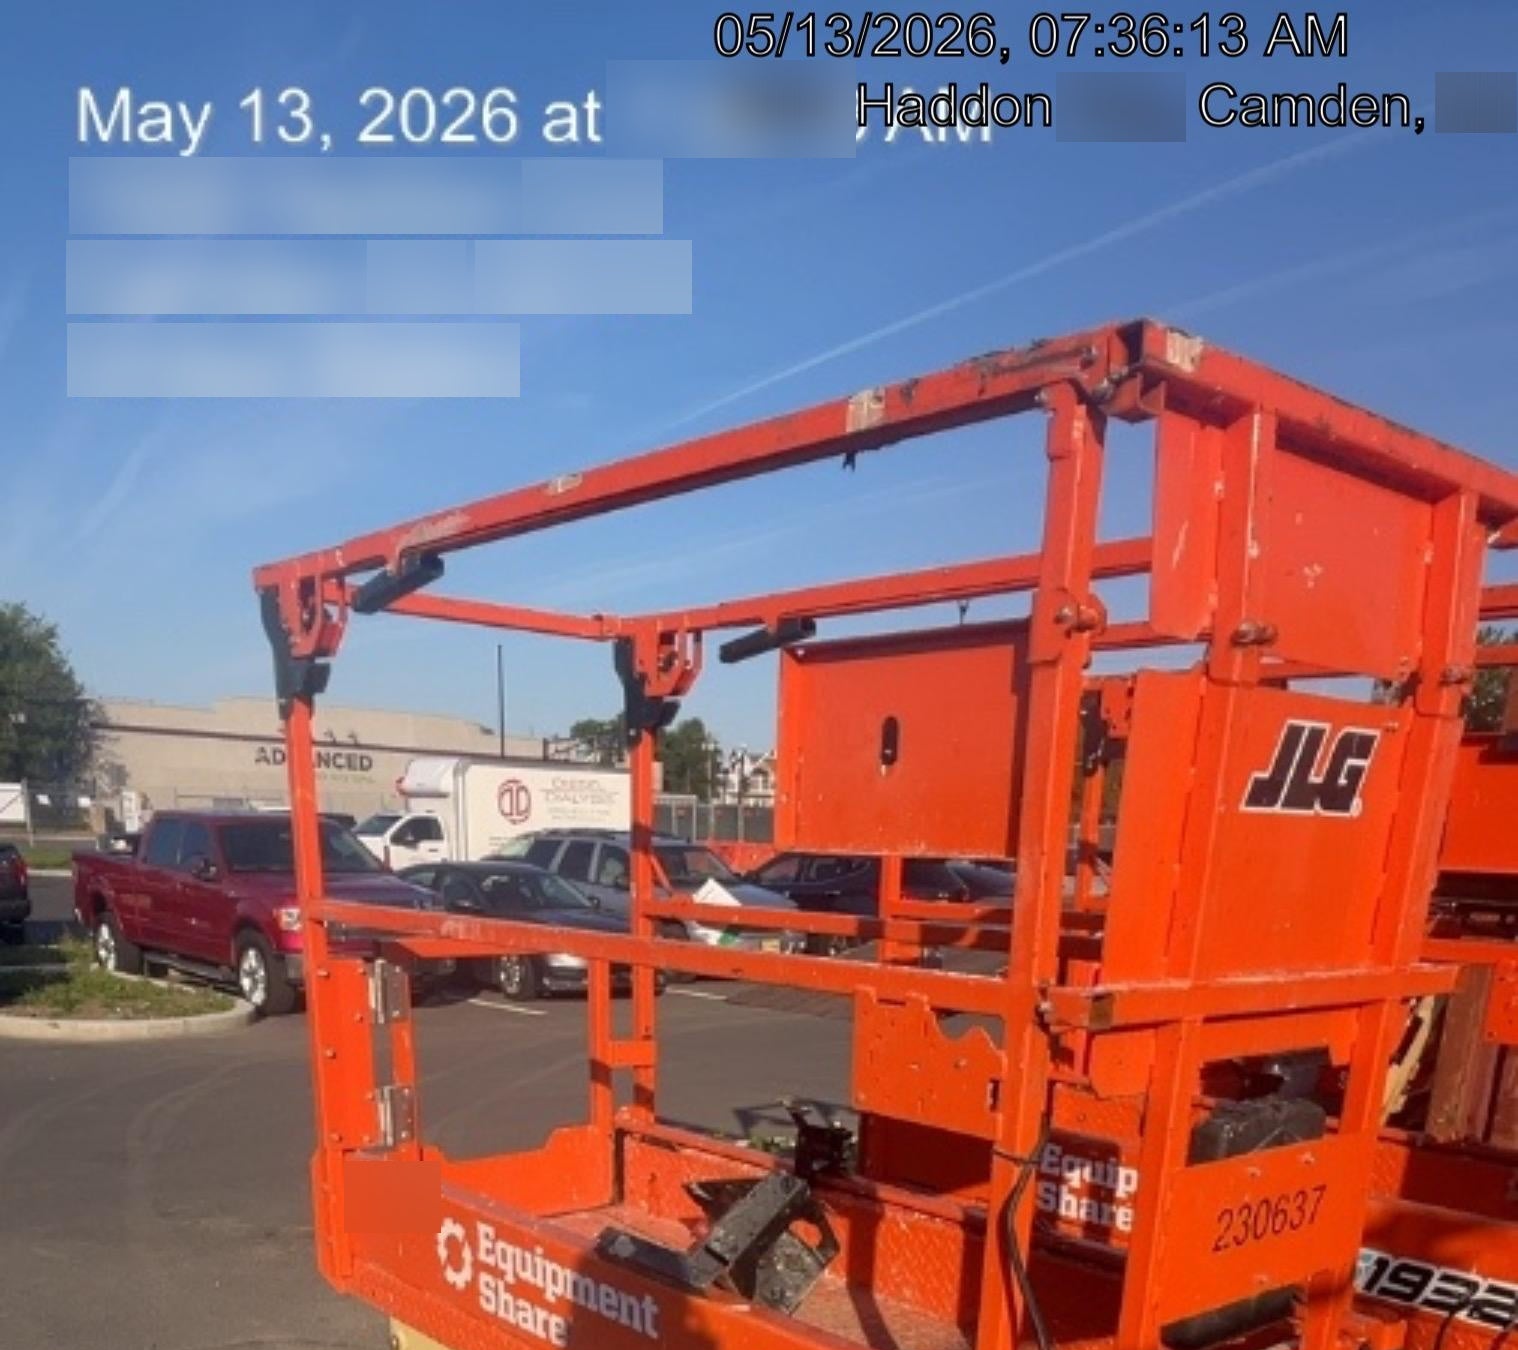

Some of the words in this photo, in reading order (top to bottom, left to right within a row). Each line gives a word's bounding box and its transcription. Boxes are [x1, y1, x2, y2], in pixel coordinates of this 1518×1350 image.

[254, 746, 374, 772] ADNCED
[1240, 720, 1381, 816] JLG
[1037, 1180, 1134, 1233] Share
[1211, 1184, 1327, 1252] 230637
[477, 1221, 659, 1339] Equipment
[478, 1271, 568, 1347] Share
